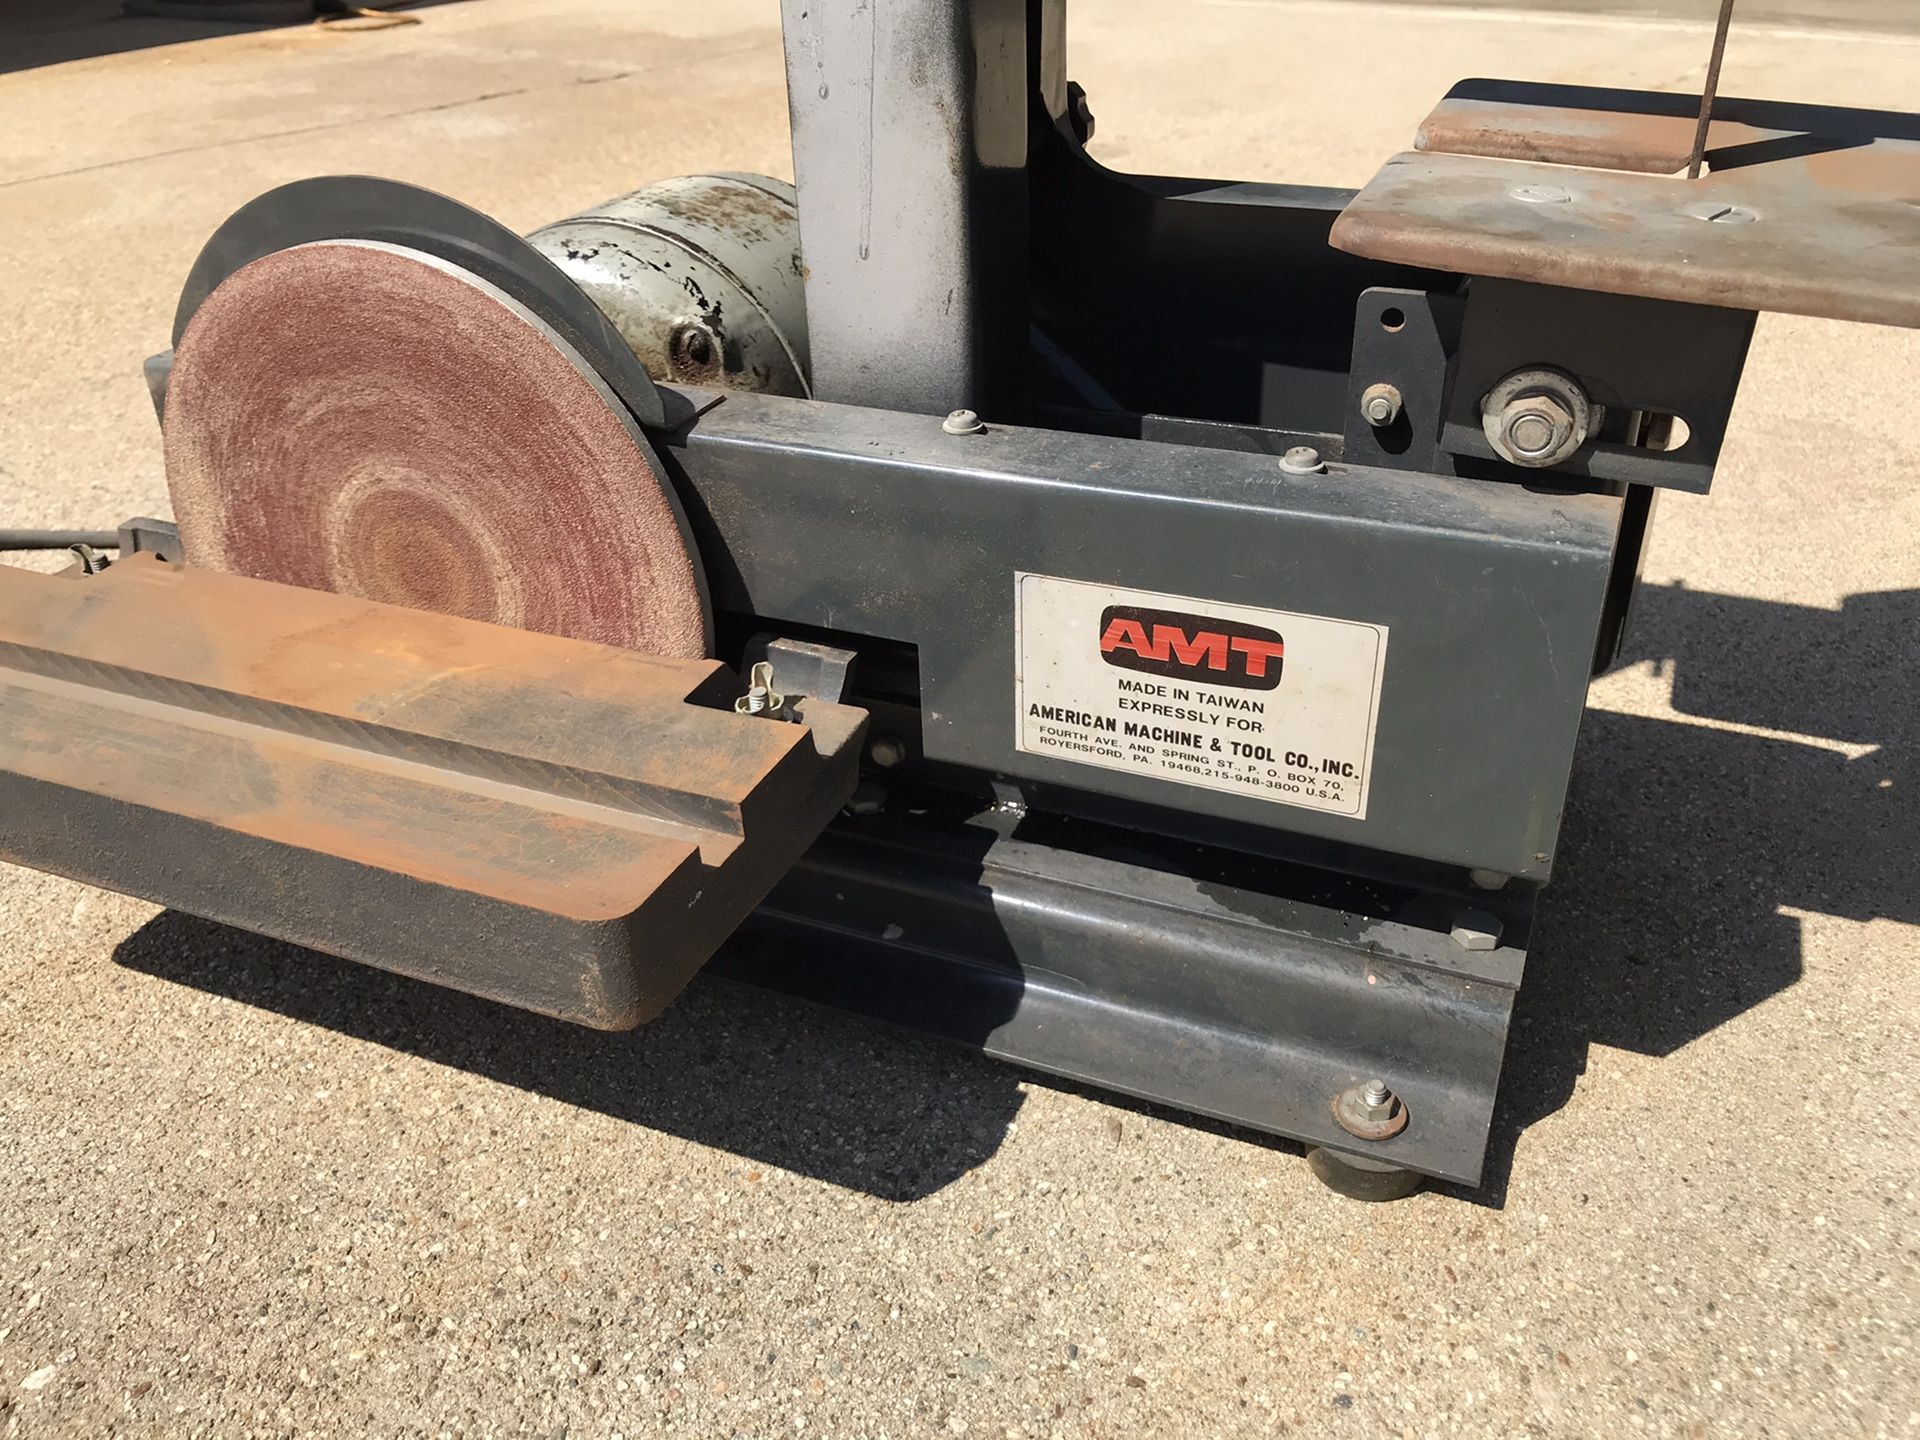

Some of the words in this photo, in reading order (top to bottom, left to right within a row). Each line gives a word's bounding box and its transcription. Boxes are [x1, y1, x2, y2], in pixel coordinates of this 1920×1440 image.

[1100, 617, 1285, 677] AMT
[1118, 678, 1167, 697] MADE
[1173, 688, 1190, 701] IN
[1196, 692, 1265, 714] TAIWAN
[1118, 698, 1220, 725] EXPRESSLY
[1029, 703, 1117, 732] AMERICAN
[1124, 721, 1203, 749] MACHINE
[1210, 737, 1222, 753] &
[1230, 741, 1275, 762] TOOL
[1039, 725, 1088, 741] FOURTH
[1094, 736, 1122, 748] AVE.
[1128, 743, 1155, 754] AND
[1162, 749, 1210, 765] SPRING
[1287, 773, 1316, 785] BOX
[1132, 754, 1152, 765] PA.
[1305, 788, 1345, 802] U.S.A.
